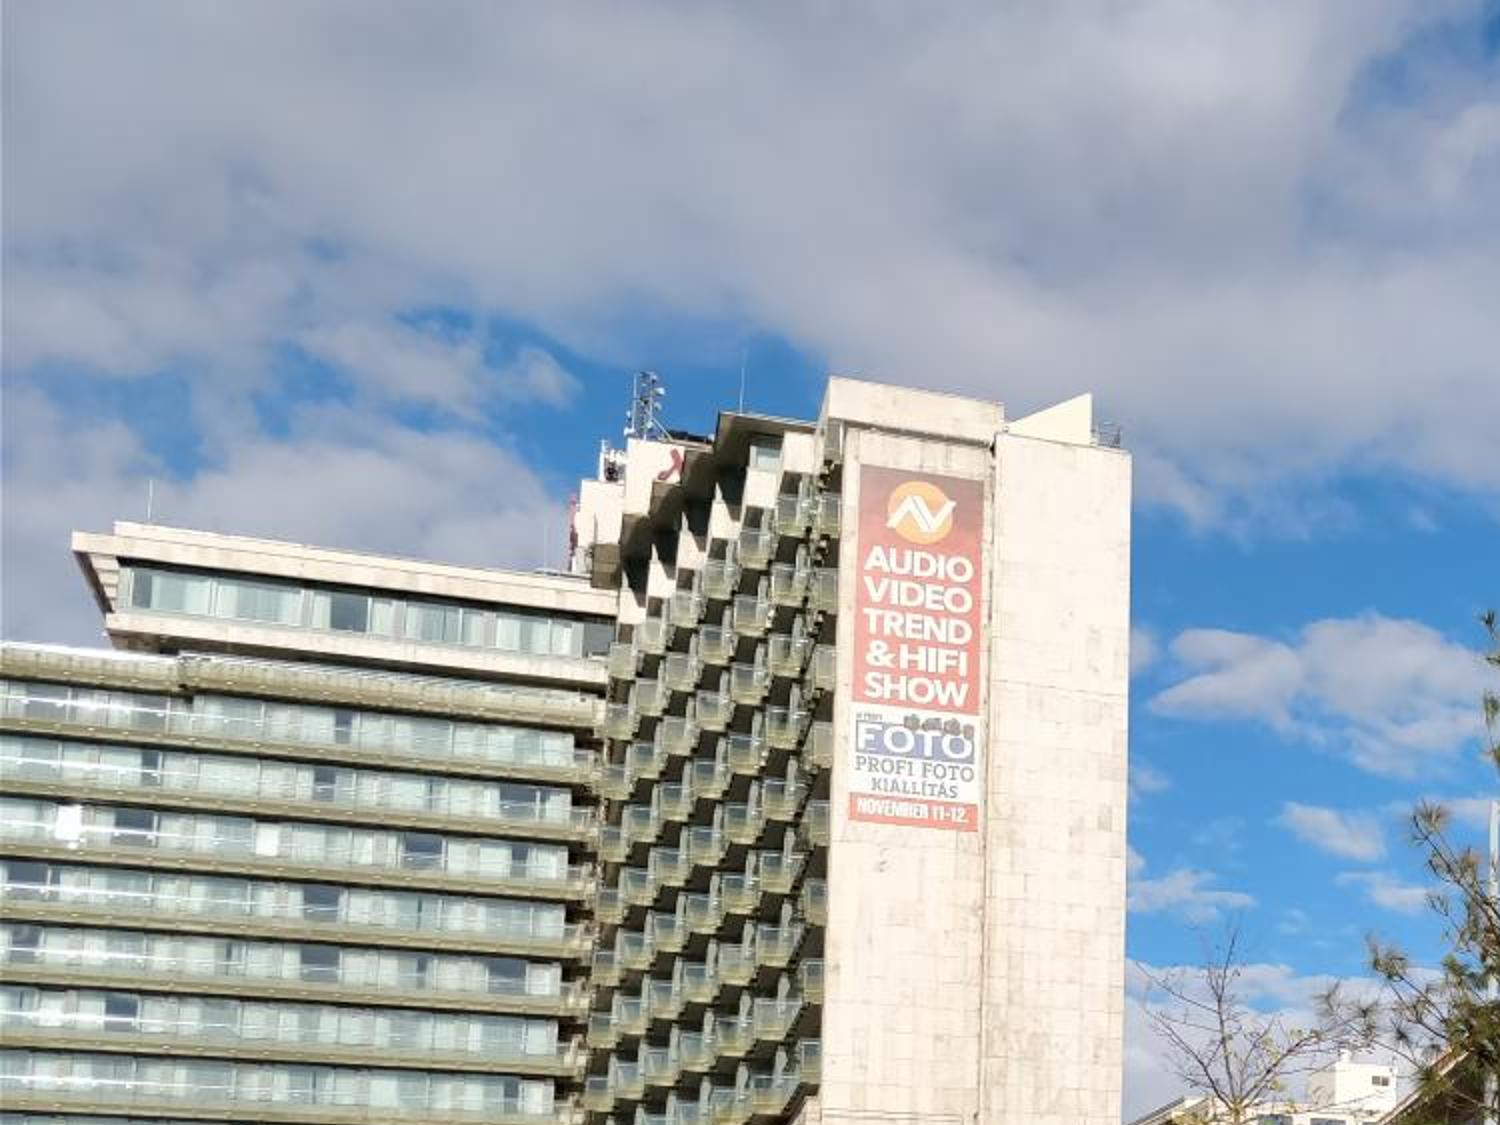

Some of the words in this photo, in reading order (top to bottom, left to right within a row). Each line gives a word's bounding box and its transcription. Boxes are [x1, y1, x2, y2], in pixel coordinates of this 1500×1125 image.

[864, 545, 975, 583] AUDIO
[863, 576, 973, 614] VIDEO
[863, 607, 973, 645] TREND
[865, 639, 897, 668] &
[898, 643, 968, 677] HIFI
[864, 671, 969, 707] SHOW
[857, 722, 974, 759] FOTO
[855, 755, 914, 777] PROFI
[921, 761, 975, 782] FOTO
[857, 798, 929, 819] NOVEMBER
